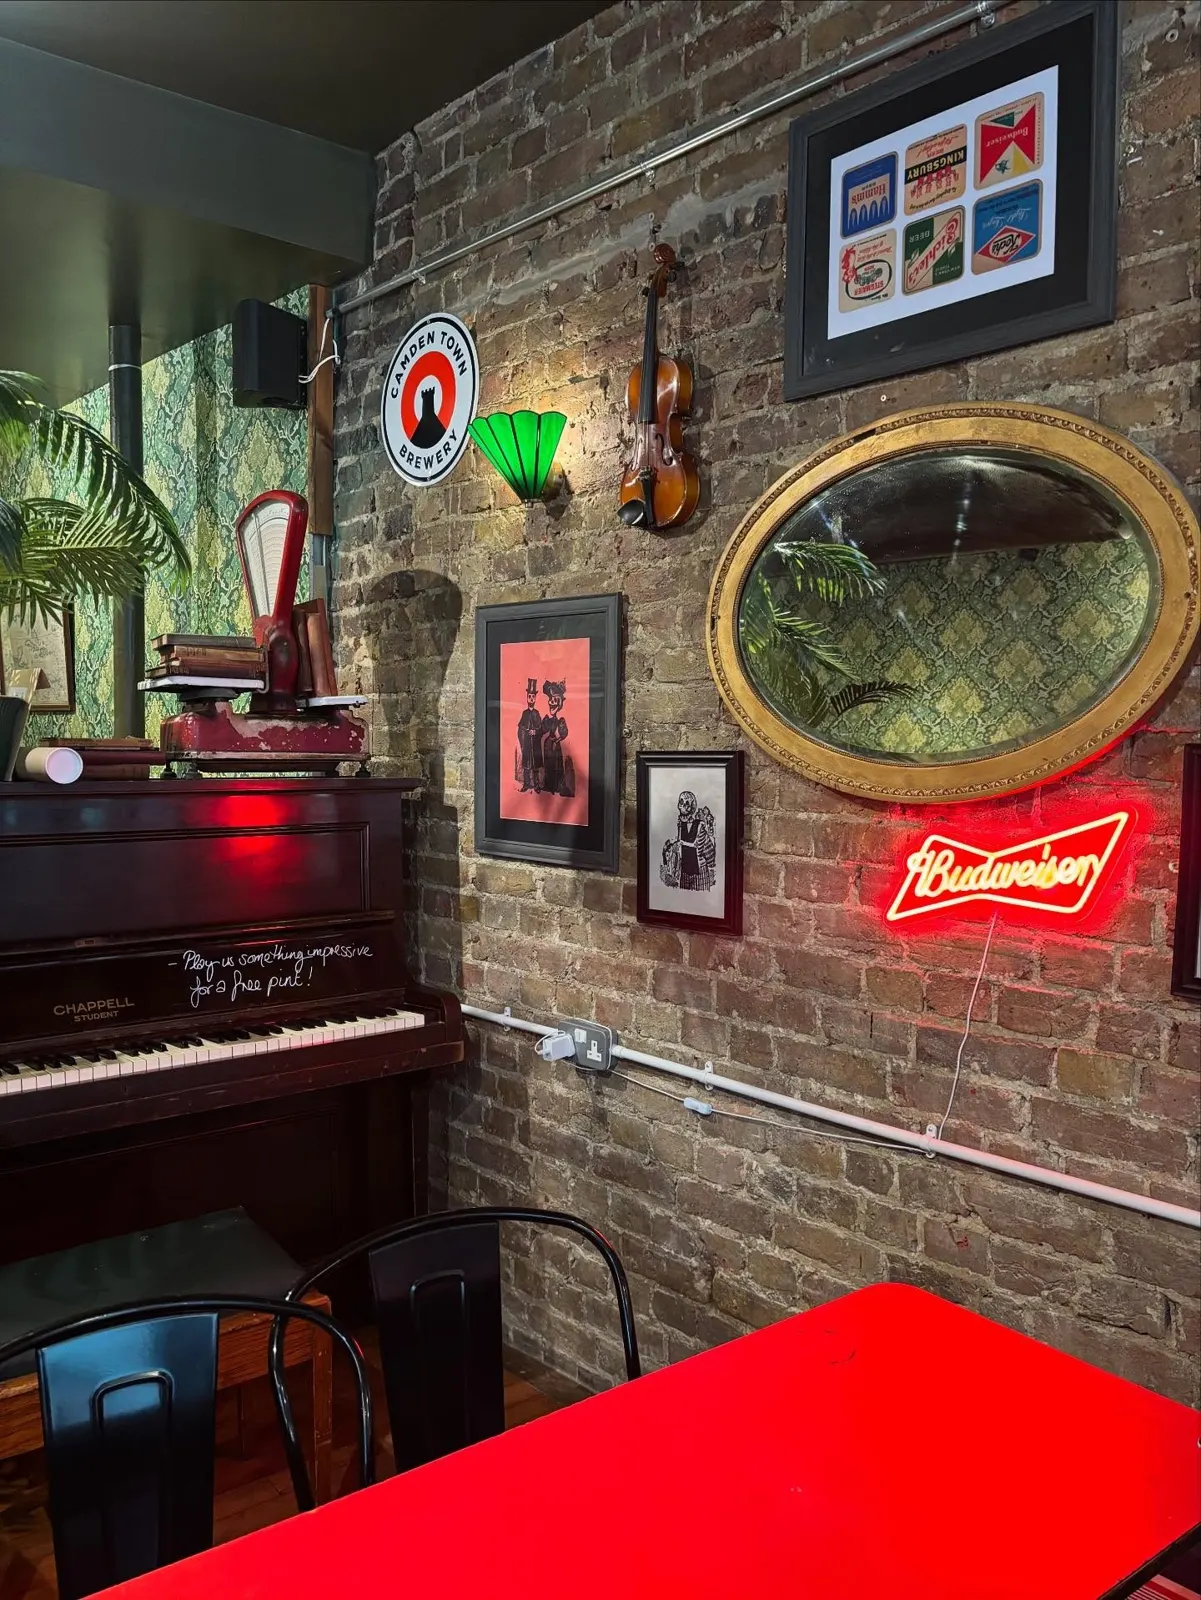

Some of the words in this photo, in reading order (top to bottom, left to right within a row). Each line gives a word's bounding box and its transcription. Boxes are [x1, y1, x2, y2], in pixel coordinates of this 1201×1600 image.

[985, 126, 1030, 147] Budweiser
[906, 150, 965, 180] KINGSBURY
[851, 182, 886, 205] Hamm's
[908, 229, 930, 244] BEER
[391, 330, 435, 399] CAMDEN
[440, 331, 468, 376] TOWN
[399, 428, 457, 470] BREWERY
[906, 843, 1102, 898] Budweiser
[182, 949, 215, 982] Play
[221, 957, 234, 968] us
[238, 944, 304, 972] something
[304, 943, 374, 966] impressive
[190, 976, 214, 1008] for
[216, 981, 227, 993] a
[231, 970, 262, 1002] free
[53, 997, 135, 1017] CHAPPELL
[73, 1010, 119, 1022] STUDENT
